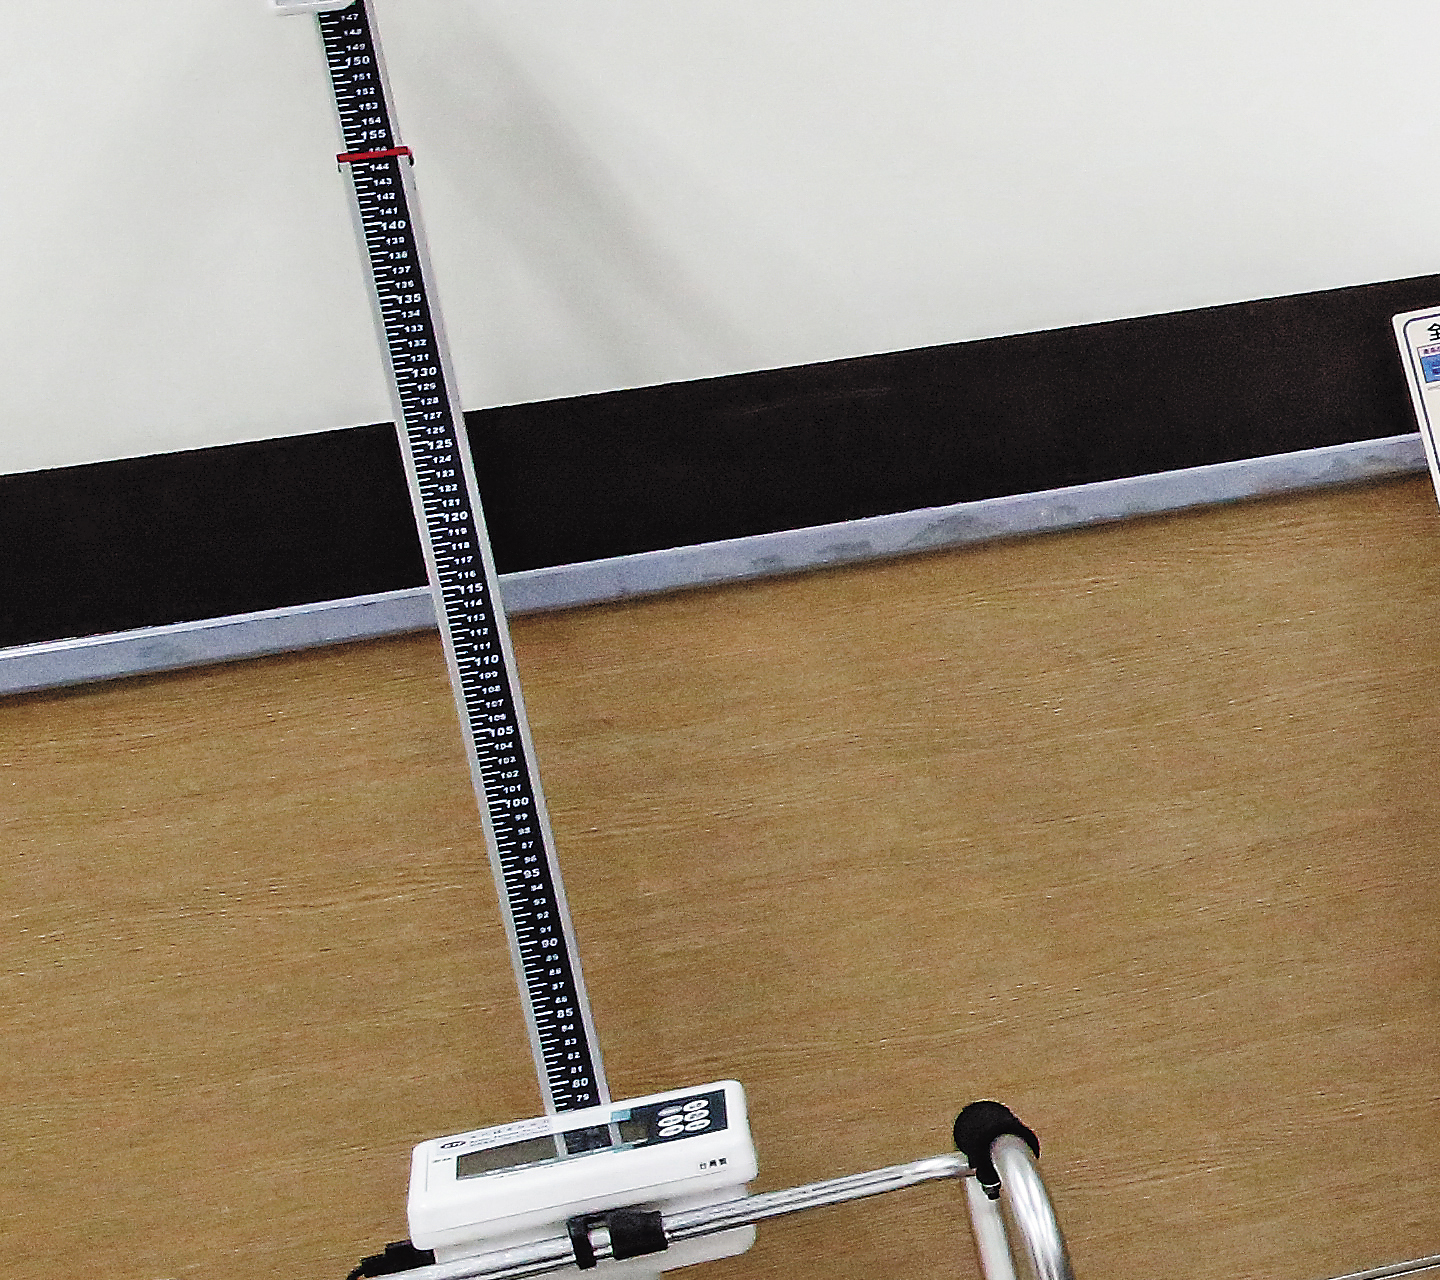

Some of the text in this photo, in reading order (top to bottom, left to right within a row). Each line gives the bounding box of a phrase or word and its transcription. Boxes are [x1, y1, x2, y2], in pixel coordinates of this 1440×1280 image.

[345, 55, 369, 66] 150
[360, 129, 386, 141] 155
[381, 221, 406, 230] 140
[396, 293, 421, 304] 135
[411, 367, 436, 378] 130
[427, 439, 452, 450] 125
[443, 511, 468, 522] 120
[458, 583, 483, 594] 115
[473, 655, 498, 666] 110
[489, 726, 514, 737] 105
[505, 796, 530, 808] 100
[524, 868, 539, 878] 95
[542, 938, 557, 948] 90
[557, 1008, 573, 1018] 85
[573, 1078, 588, 1088] 80
